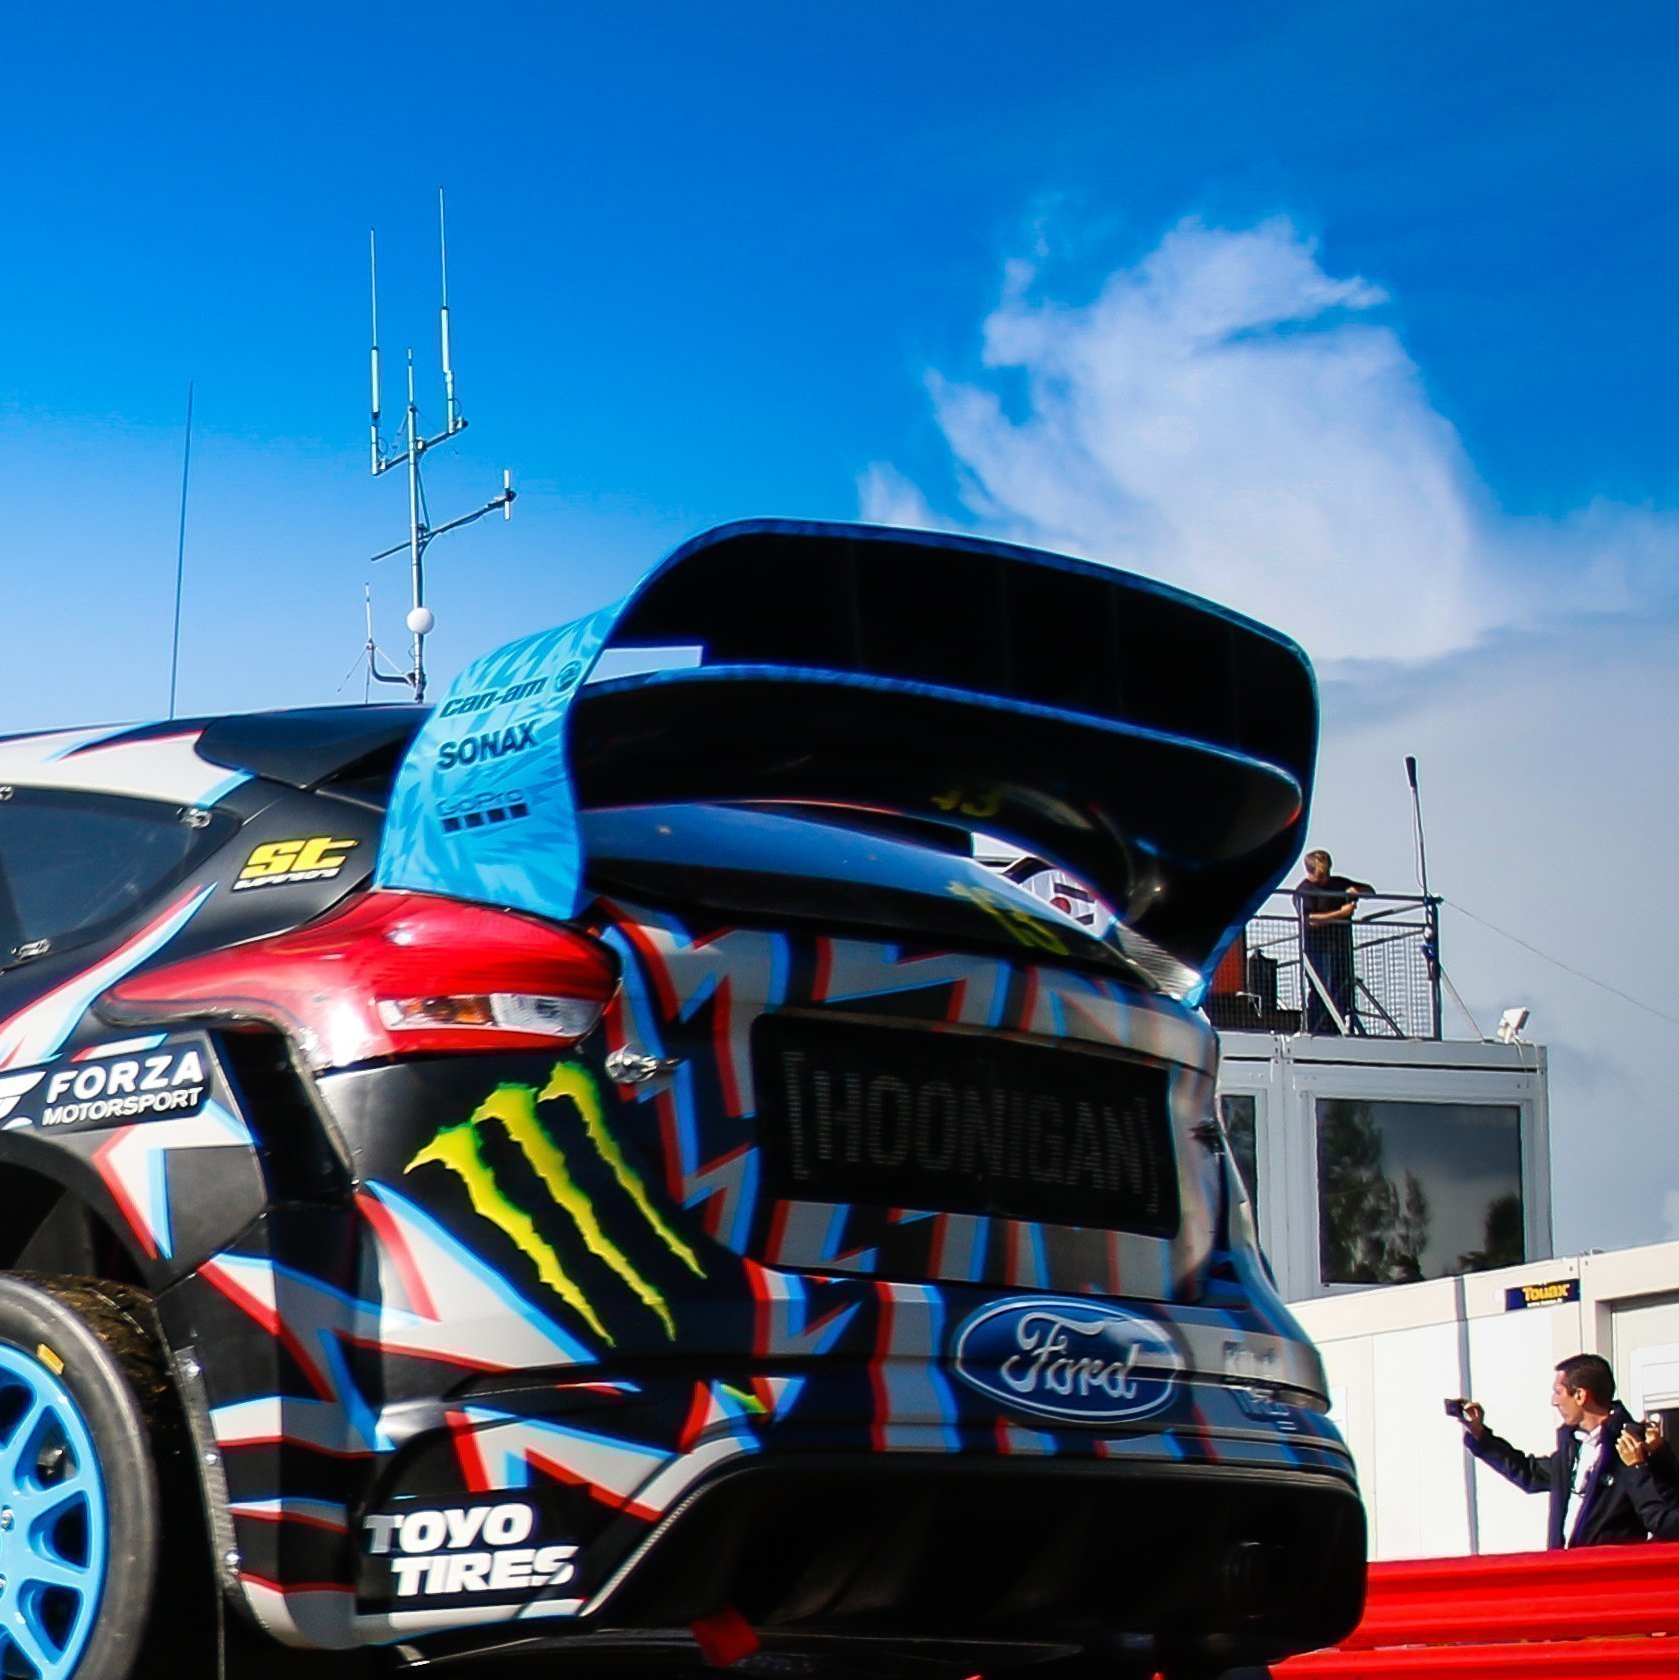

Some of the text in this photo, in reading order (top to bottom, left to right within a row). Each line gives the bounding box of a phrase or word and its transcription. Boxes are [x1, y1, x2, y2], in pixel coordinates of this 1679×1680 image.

[438, 719, 538, 770] SONAX
[46, 1051, 203, 1102] FORZA
[43, 1086, 203, 1127] MOTORSPORT
[1000, 1311, 1143, 1399] Ford
[366, 1503, 533, 1554] TOYO
[391, 1546, 579, 1598] TIRES
